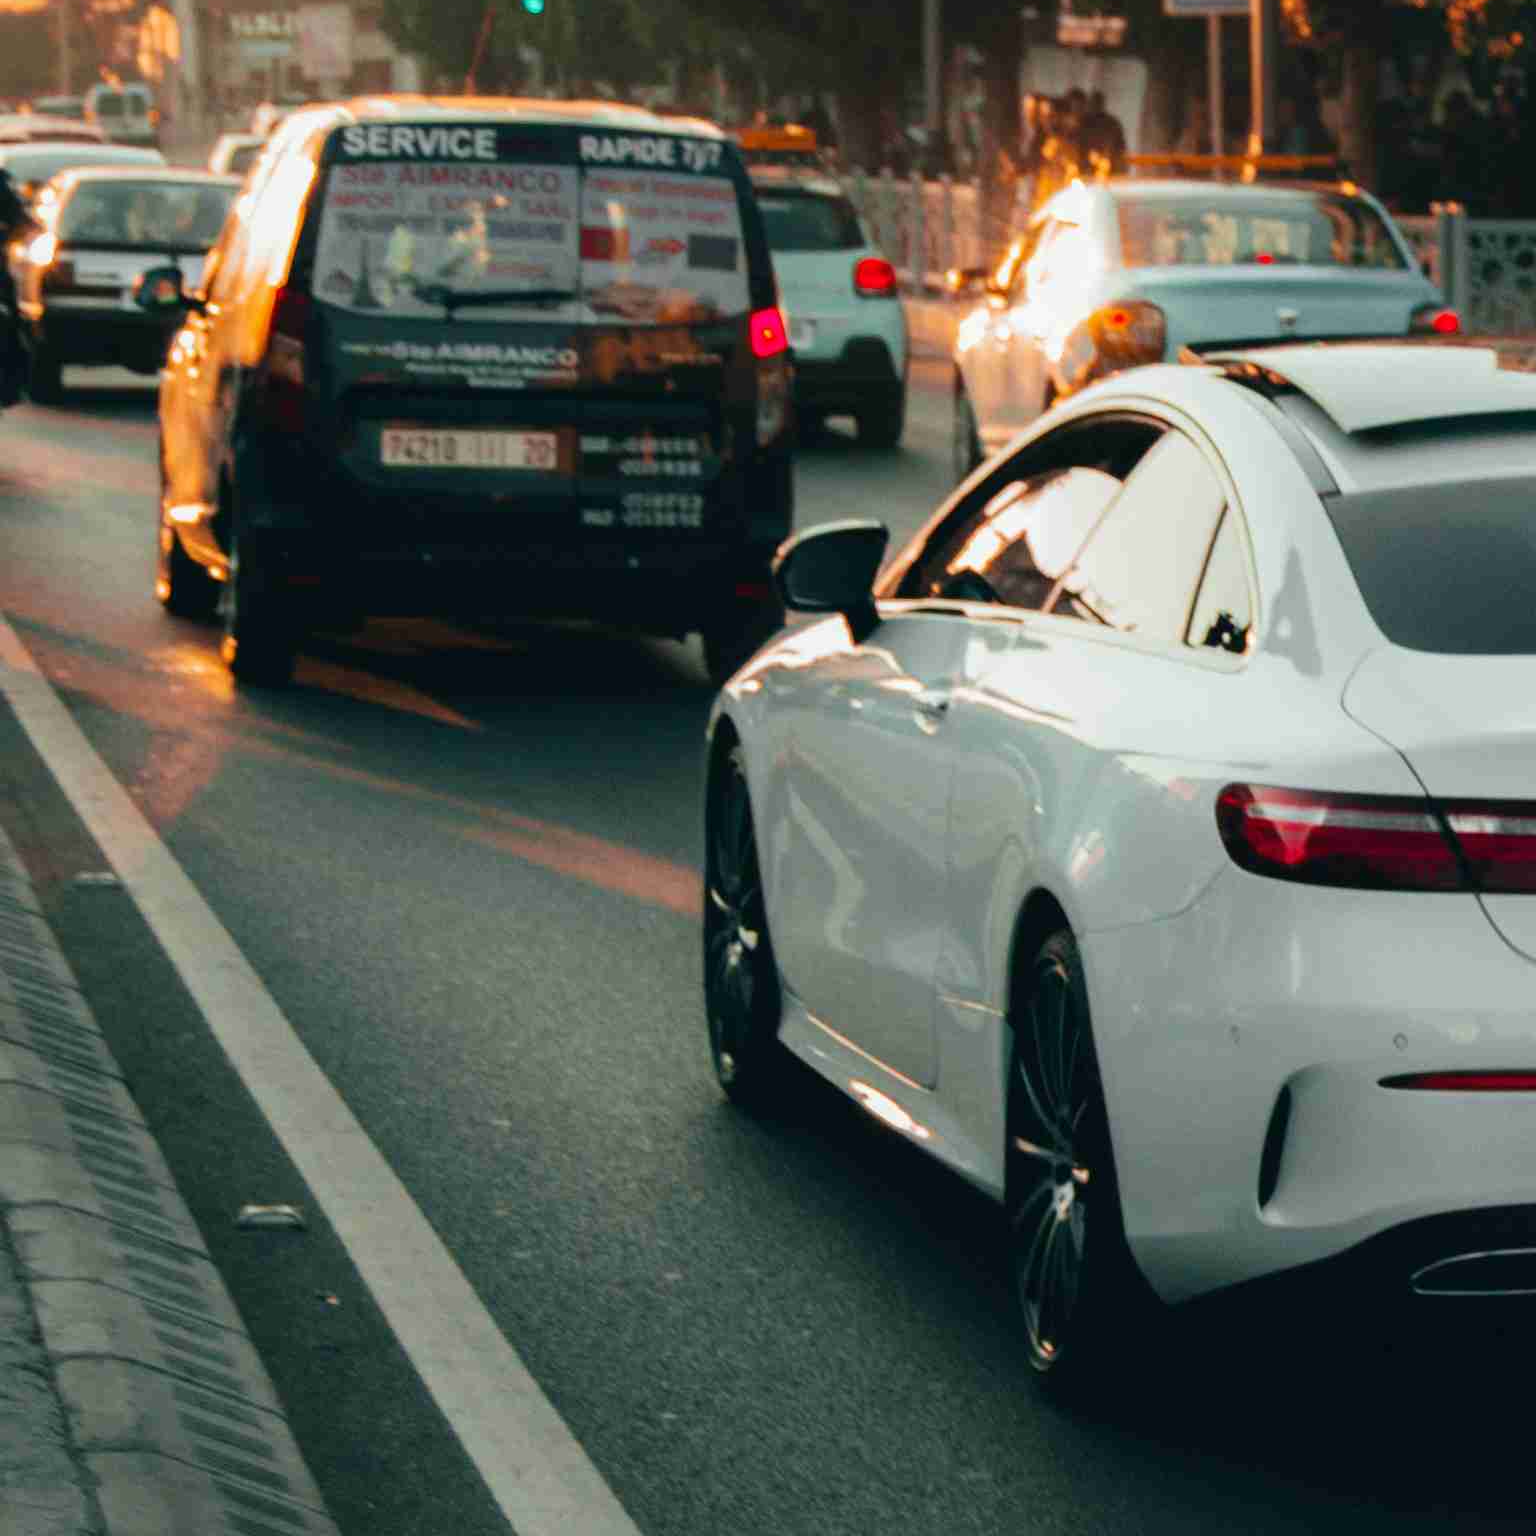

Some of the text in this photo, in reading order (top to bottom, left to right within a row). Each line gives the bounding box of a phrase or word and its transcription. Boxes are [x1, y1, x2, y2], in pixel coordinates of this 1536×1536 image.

[343, 128, 498, 159] SERVICE
[580, 135, 675, 166] RAPIDE
[399, 167, 561, 194] AIMRANCO
